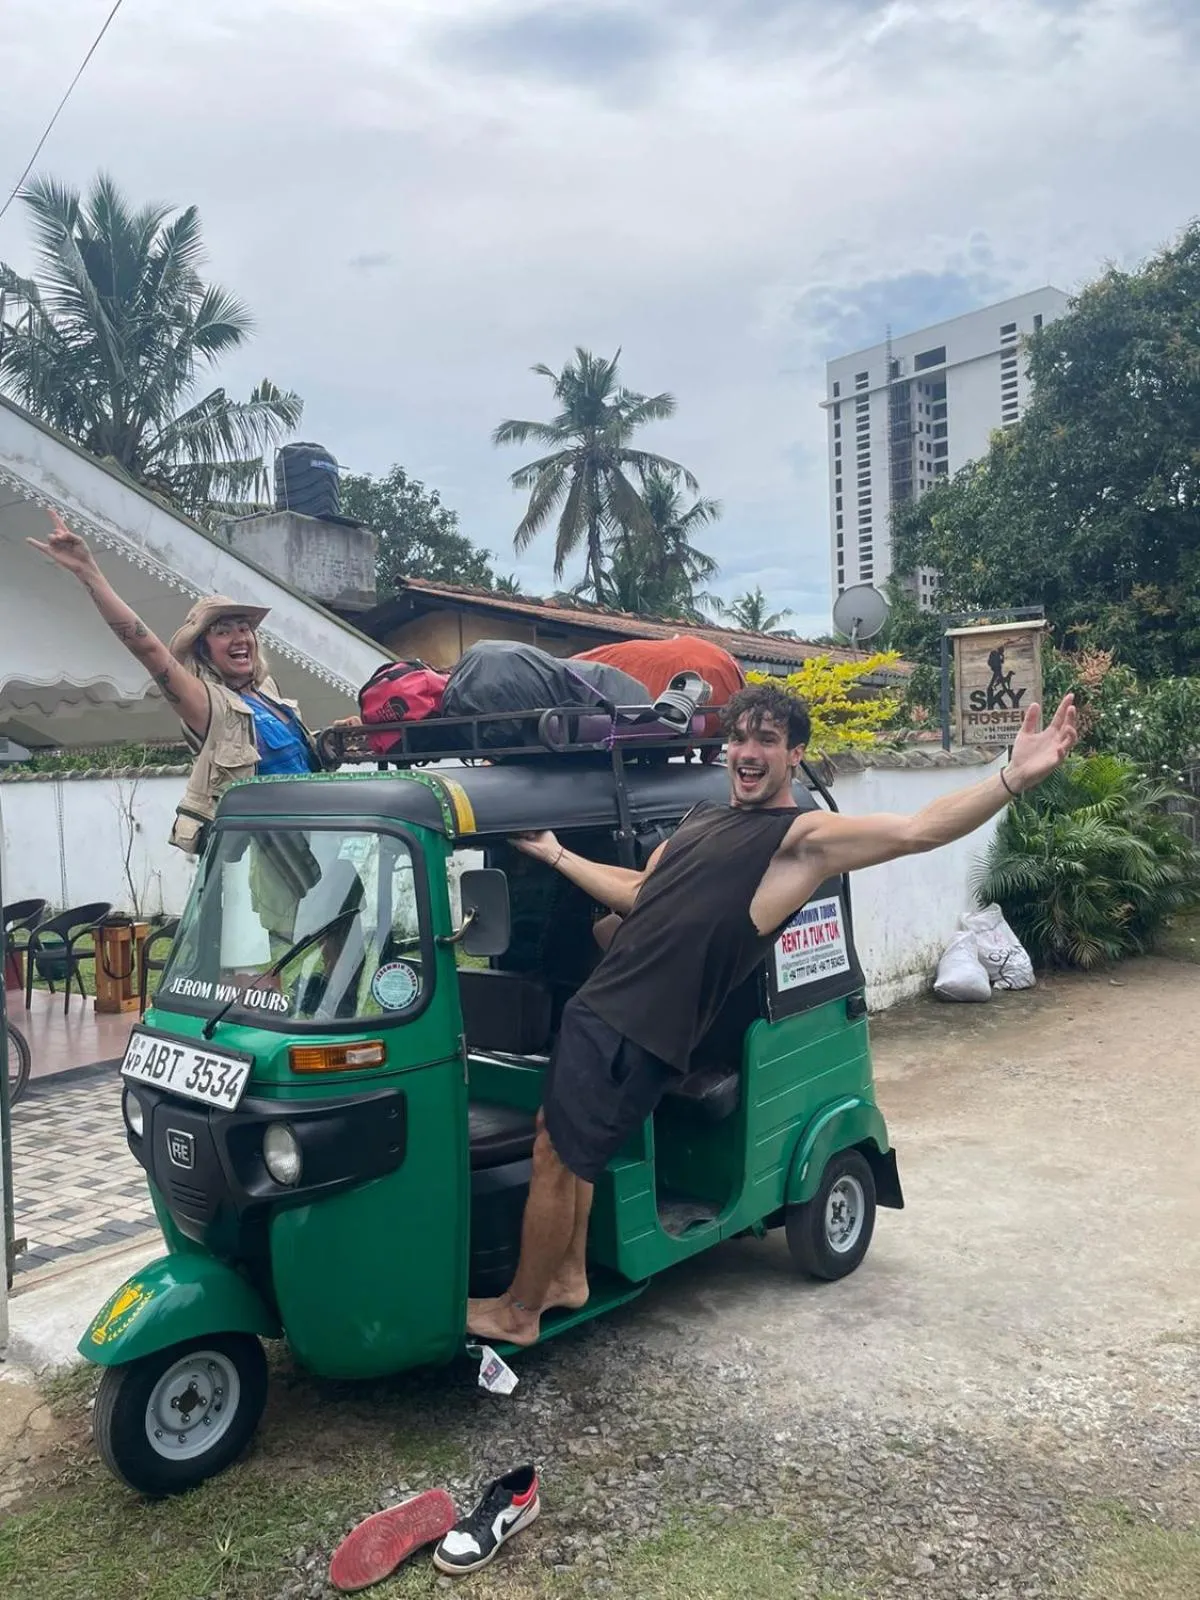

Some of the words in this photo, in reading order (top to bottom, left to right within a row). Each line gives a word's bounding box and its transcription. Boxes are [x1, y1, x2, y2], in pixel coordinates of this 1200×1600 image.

[969, 688, 1027, 711] SKY
[782, 930, 801, 954] RENT
[803, 928, 809, 950] A
[809, 924, 825, 948] TUK
[825, 920, 840, 943] TUK
[170, 977, 213, 999] JEROM
[214, 983, 241, 1003] WIN
[243, 988, 290, 1012] TOURS
[124, 1052, 142, 1072] WP
[141, 1043, 185, 1083] ABT
[185, 1055, 244, 1102] 3534
[172, 1141, 190, 1162] RE
